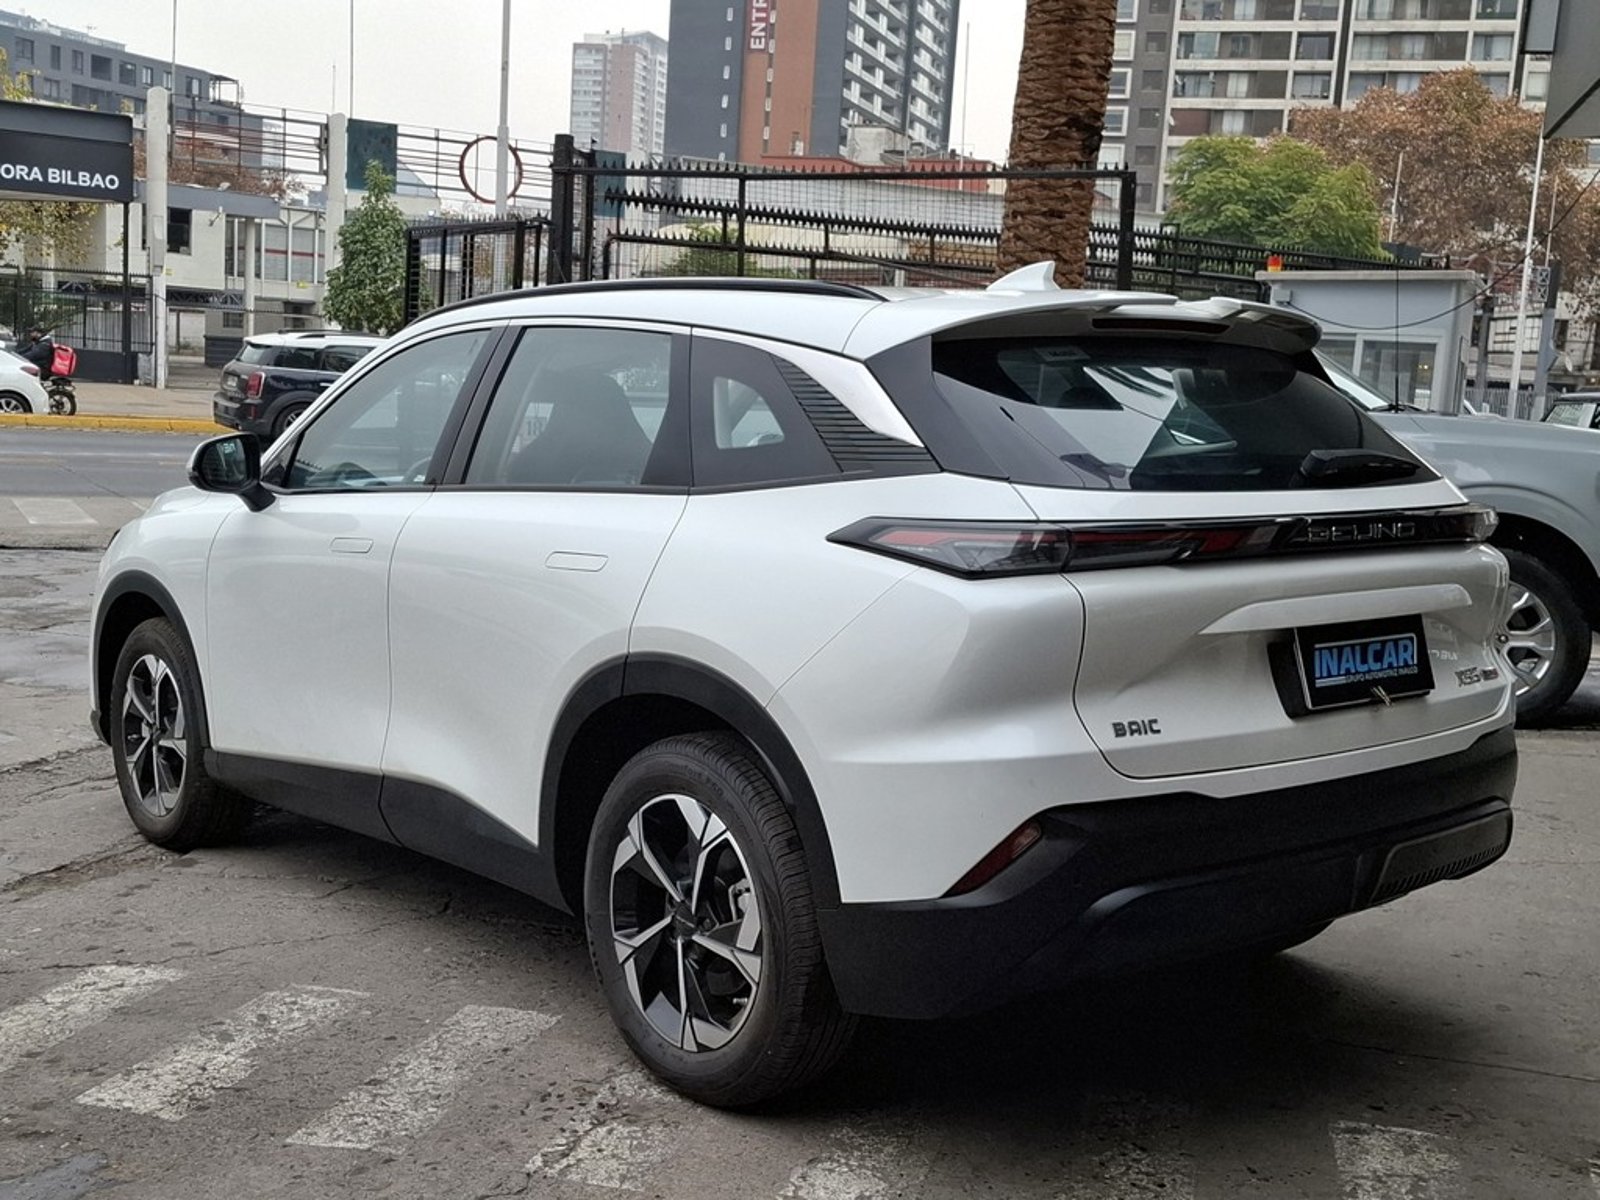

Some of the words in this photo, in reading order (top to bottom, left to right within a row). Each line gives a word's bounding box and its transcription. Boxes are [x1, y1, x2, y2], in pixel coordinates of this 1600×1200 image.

[47, 167, 119, 190] BILBAO
[1314, 638, 1413, 678] INALCAR
[1112, 718, 1161, 738] BAIC
